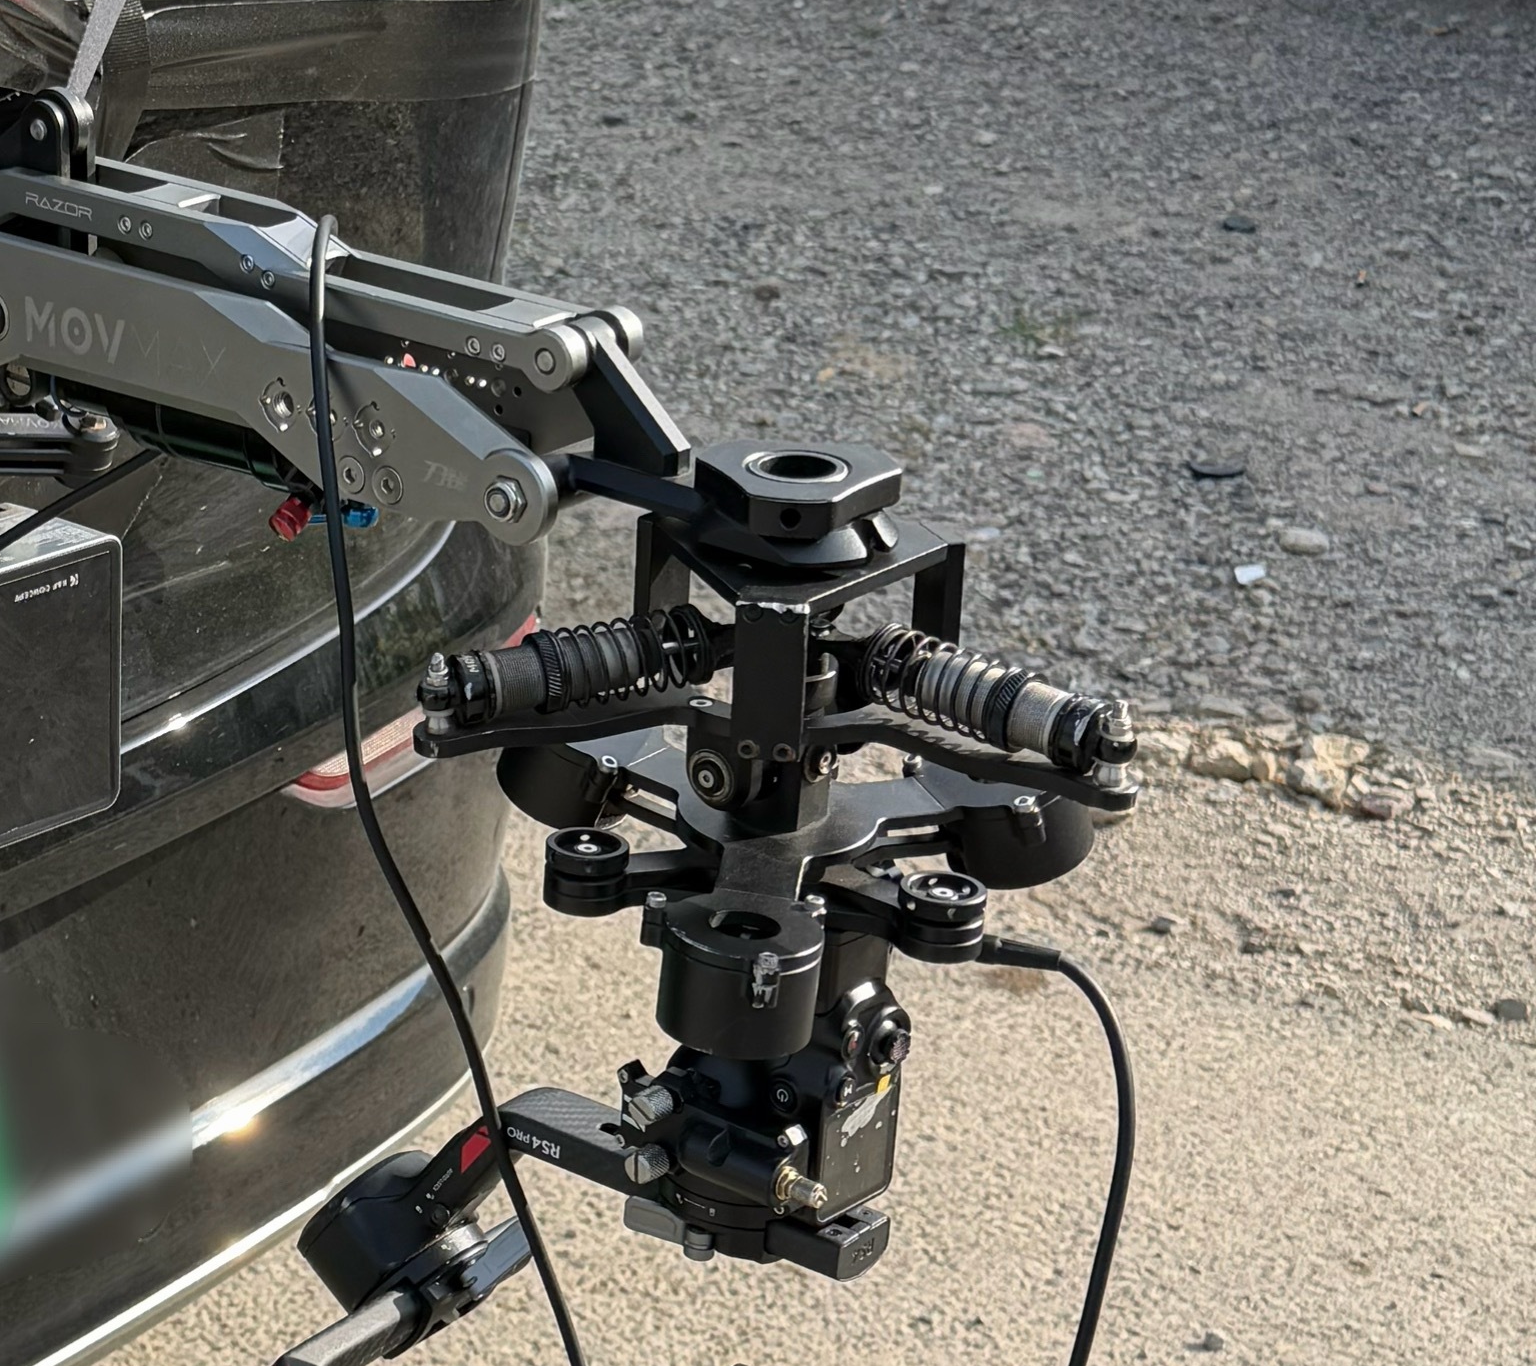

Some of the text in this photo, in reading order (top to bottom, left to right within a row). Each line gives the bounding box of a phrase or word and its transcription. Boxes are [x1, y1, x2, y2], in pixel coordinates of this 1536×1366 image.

[25, 191, 93, 222] RAZOR
[506, 1126, 561, 1159] RS4 PRO
